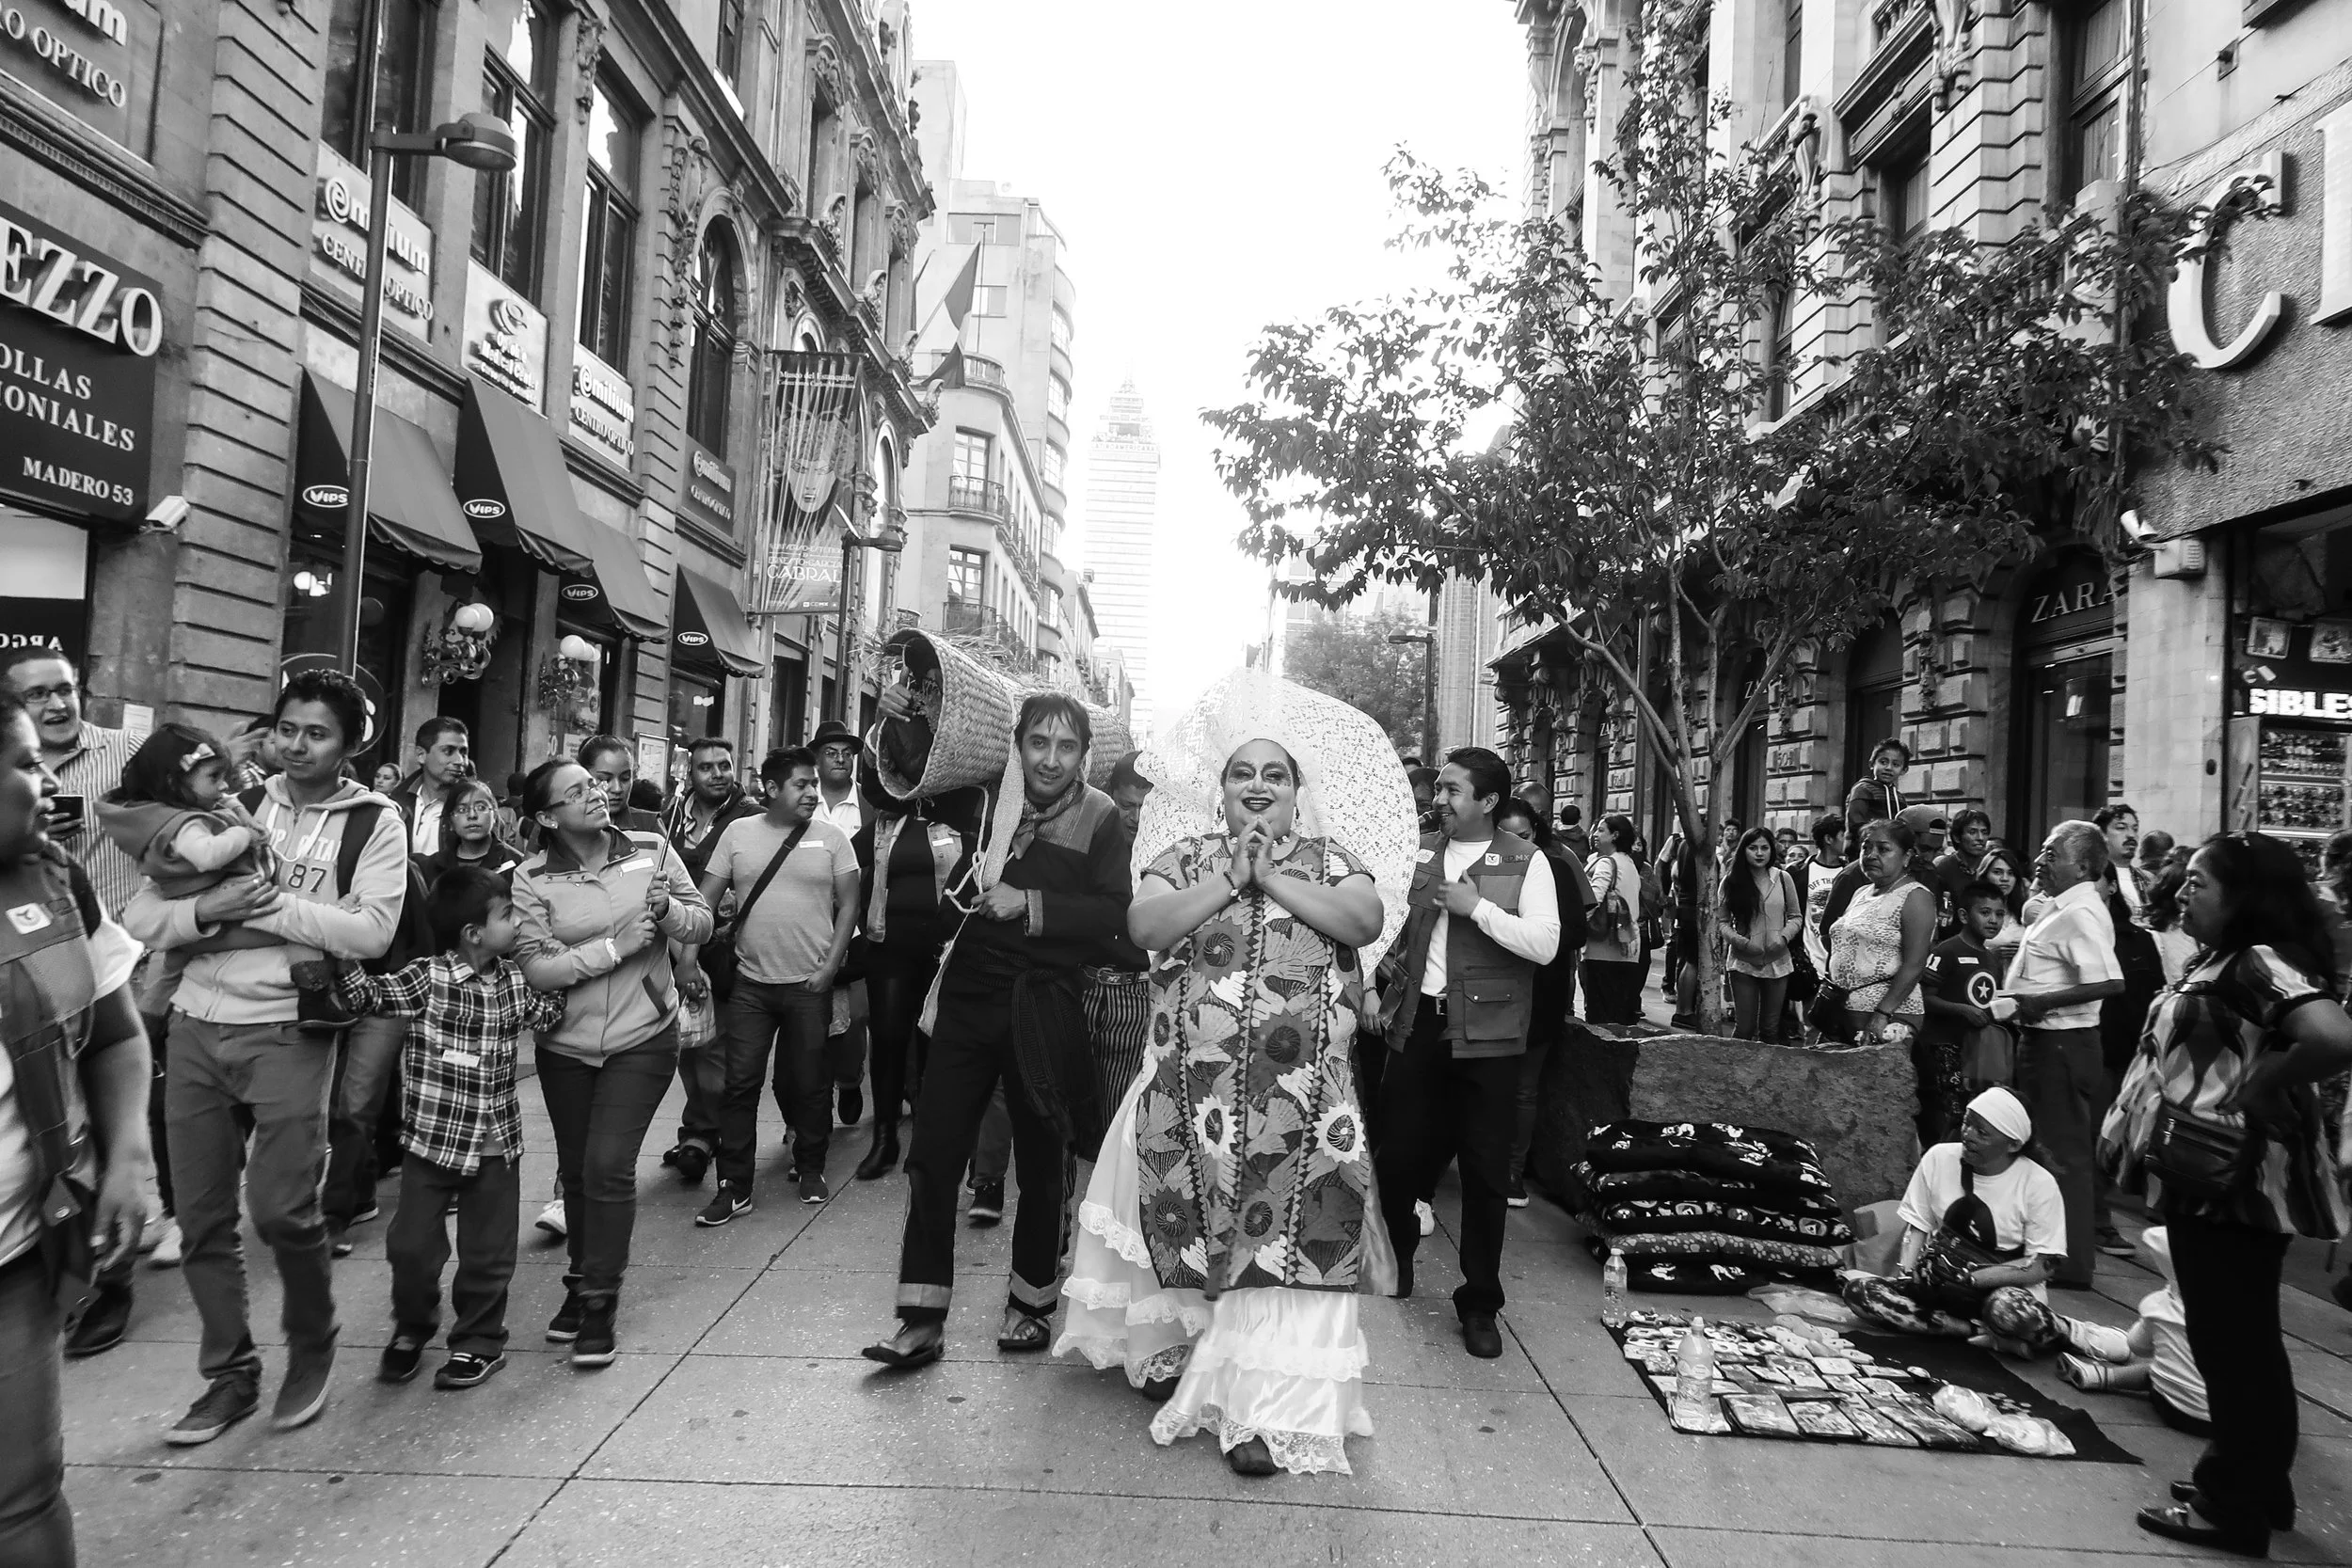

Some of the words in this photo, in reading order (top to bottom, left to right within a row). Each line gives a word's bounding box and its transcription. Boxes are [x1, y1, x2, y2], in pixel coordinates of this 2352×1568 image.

[33, 26, 126, 107] OPTICO
[0, 216, 164, 356] EZZO
[323, 234, 367, 279] CENT
[386, 277, 434, 321] OPTICO
[0, 381, 135, 451] ONIALES
[576, 406, 607, 437] CENTRO
[608, 429, 634, 455] OPTICO
[24, 456, 110, 499] MADERO
[113, 484, 134, 506] 53
[767, 564, 842, 583] CABRAL
[2031, 581, 2118, 624] ZARA
[287, 863, 327, 894] 87
[1808, 879, 1820, 892] OFF
